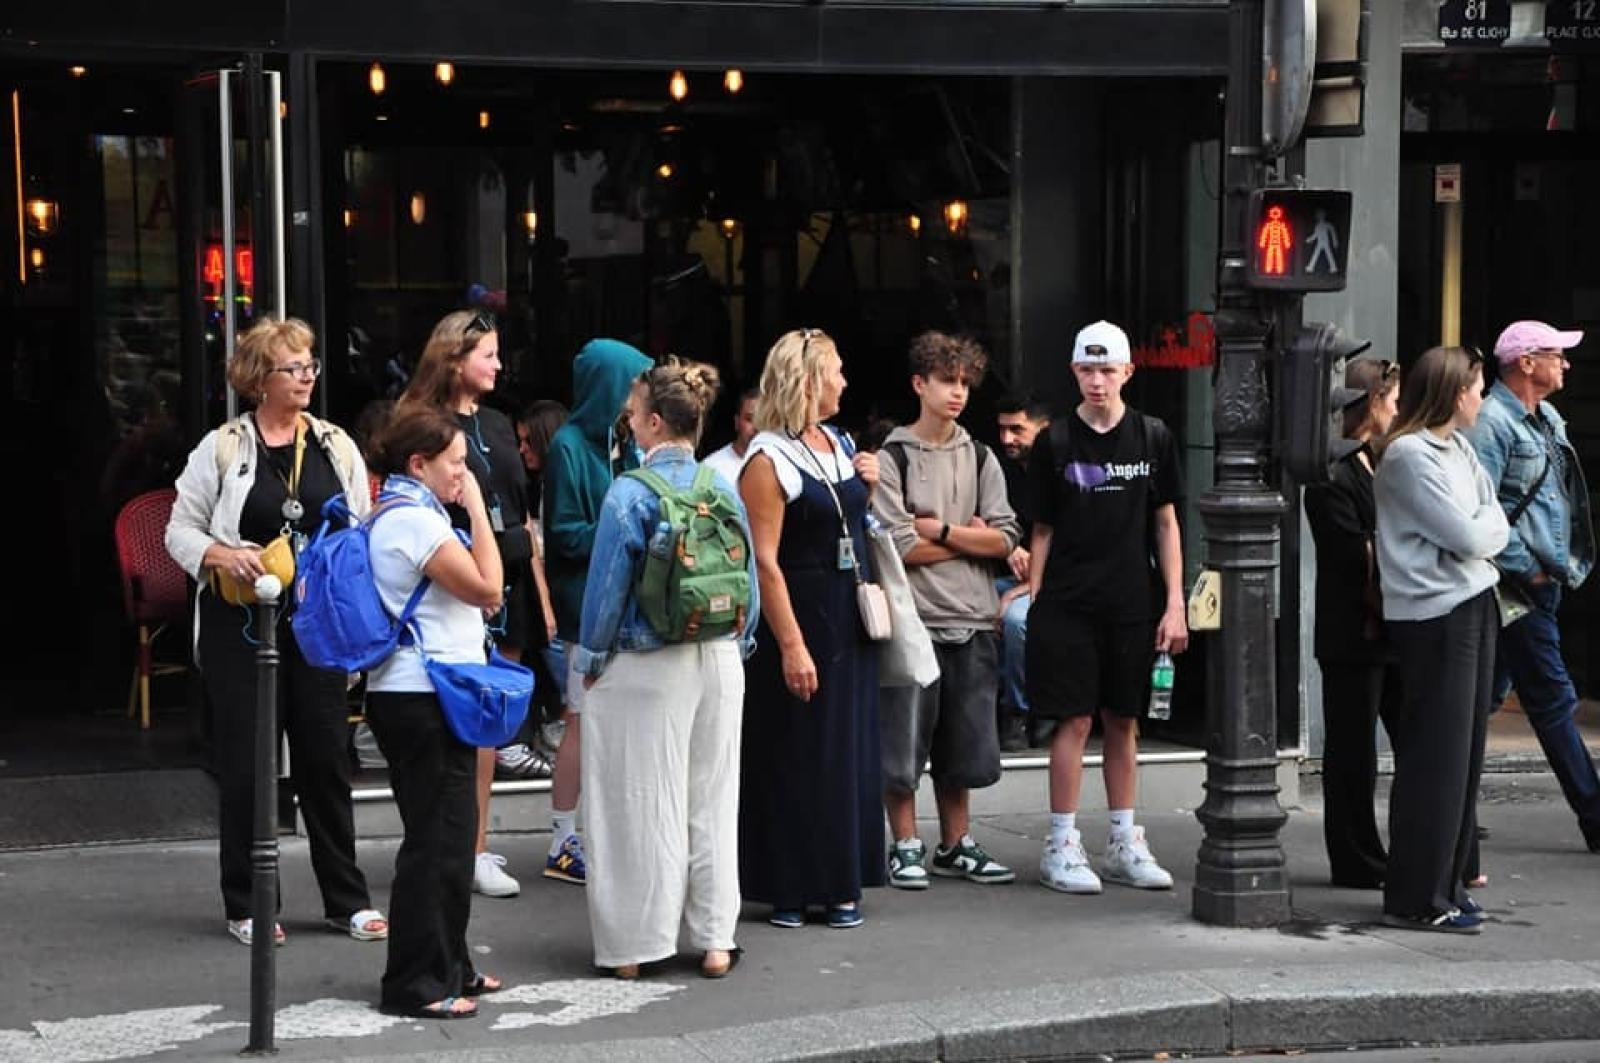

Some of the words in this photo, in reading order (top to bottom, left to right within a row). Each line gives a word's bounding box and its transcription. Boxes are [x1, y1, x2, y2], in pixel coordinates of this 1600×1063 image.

[1464, 0, 1486, 20] 81
[1574, 0, 1596, 20] 12
[1546, 26, 1577, 39] PLACE
